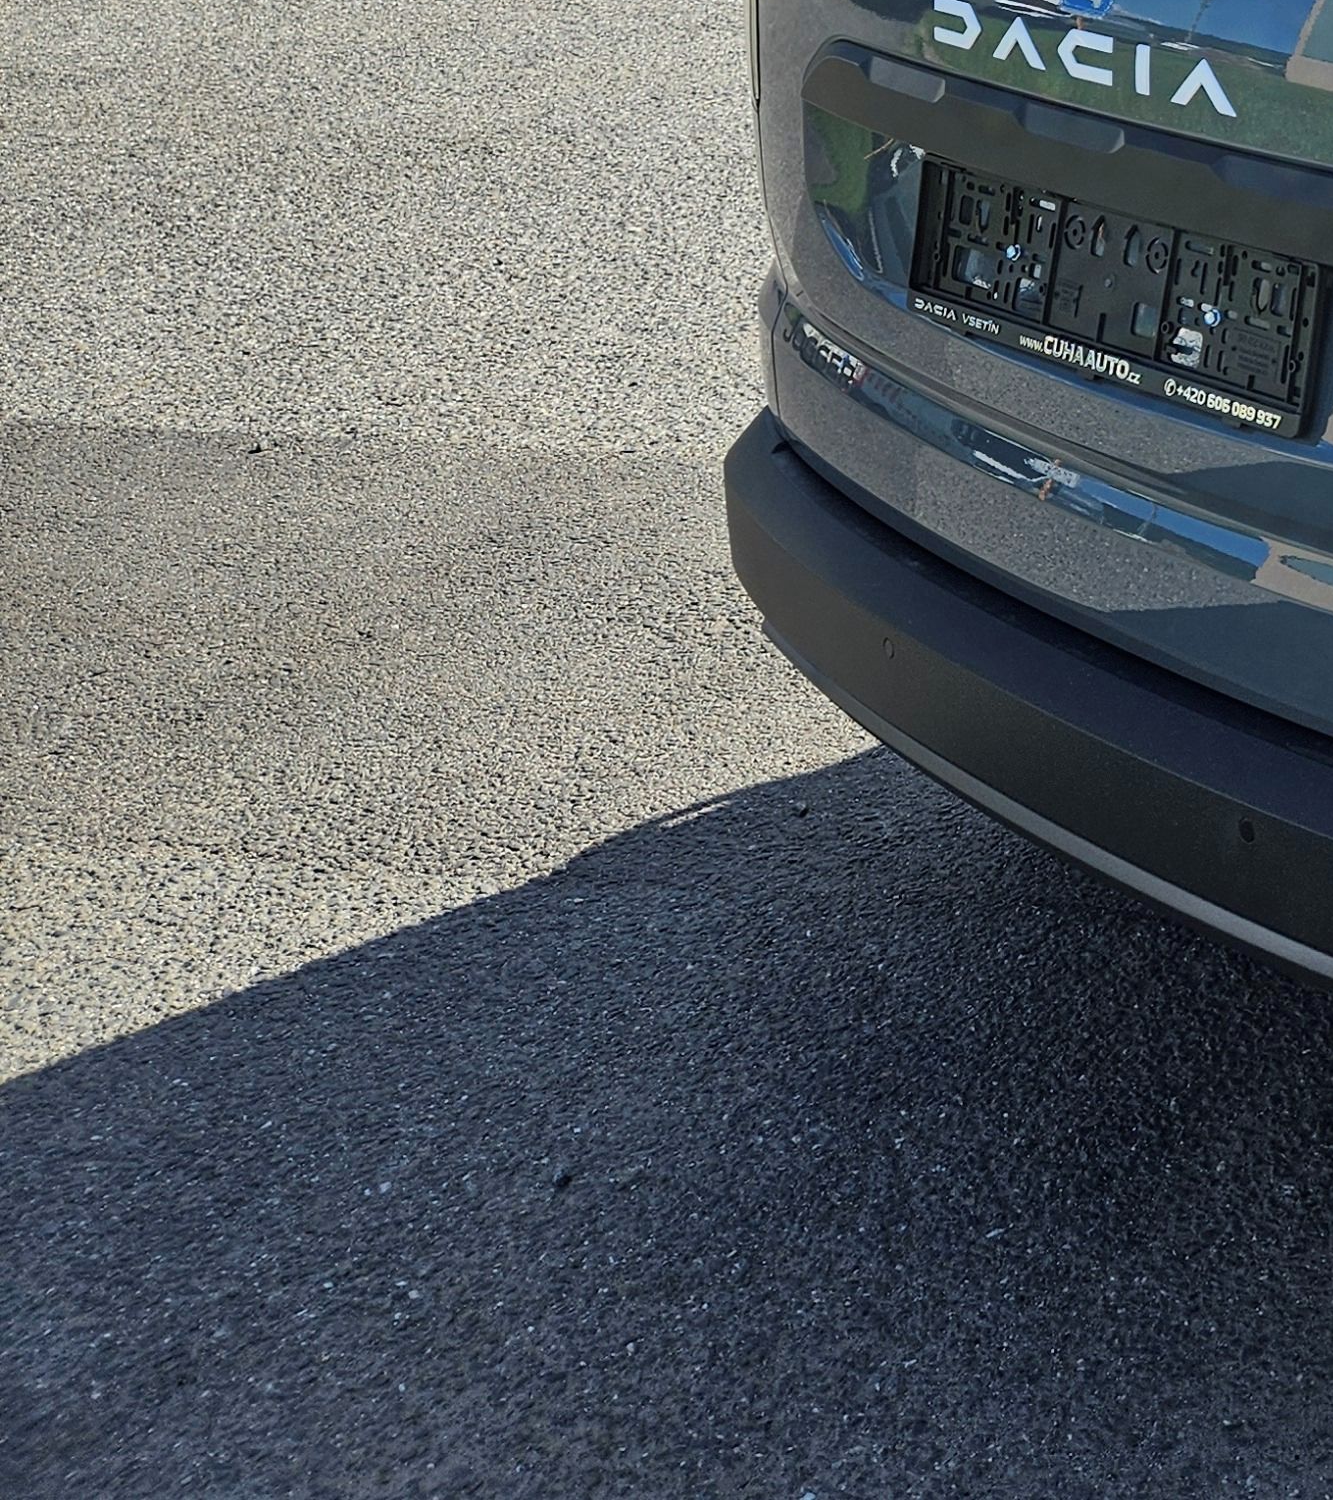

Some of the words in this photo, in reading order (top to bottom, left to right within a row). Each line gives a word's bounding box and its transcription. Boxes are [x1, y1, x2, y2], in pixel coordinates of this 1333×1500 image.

[914, 298, 957, 322] DACIA
[962, 311, 1000, 336] VSETÍN
[1019, 334, 1142, 386] www.CUHAAUTO.cz
[1176, 384, 1206, 406] +420
[1206, 393, 1231, 414] 606
[1231, 401, 1256, 422] 089
[1256, 410, 1282, 430] 937
